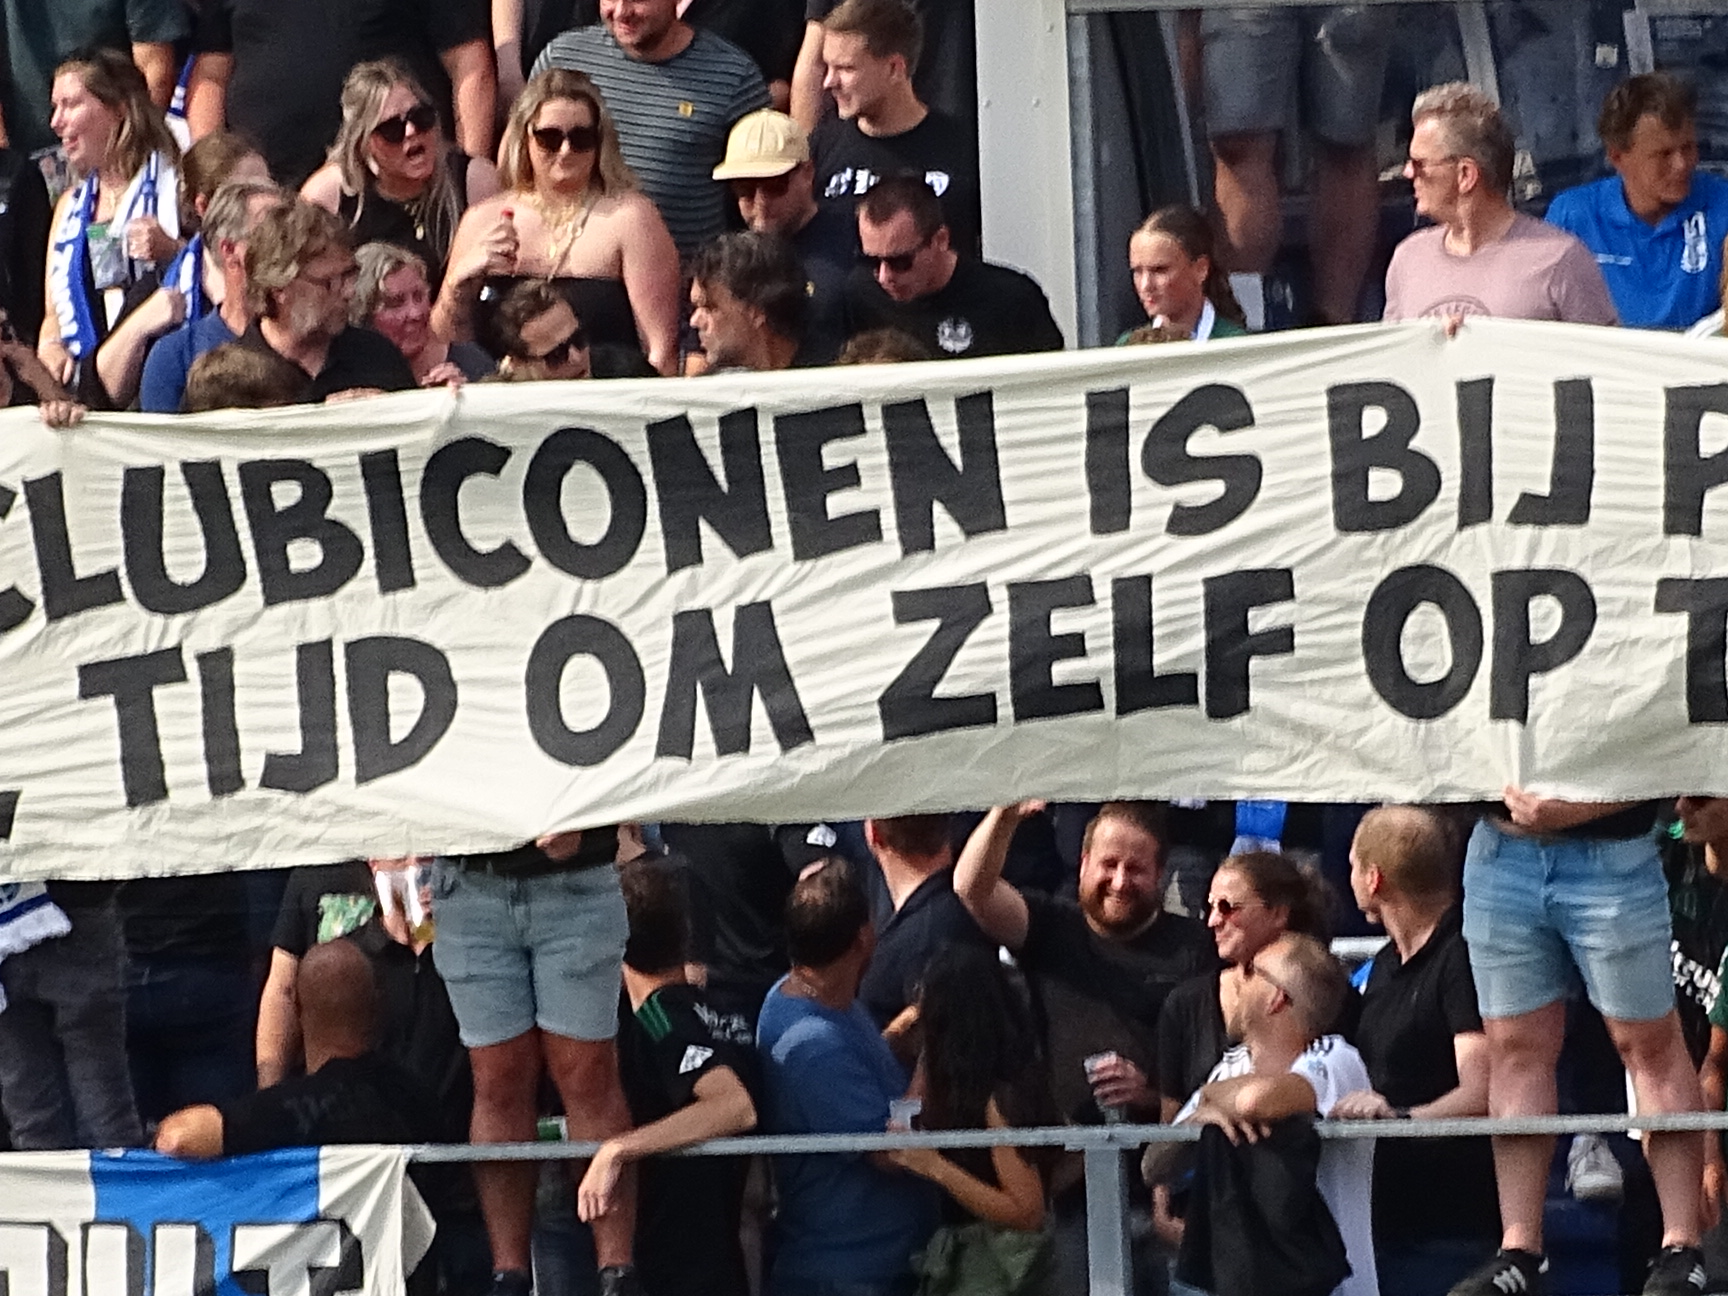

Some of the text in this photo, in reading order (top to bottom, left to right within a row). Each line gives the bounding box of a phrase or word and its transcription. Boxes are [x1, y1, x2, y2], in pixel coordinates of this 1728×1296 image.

[1085, 382, 1264, 537] IS
[1327, 376, 1595, 534] BIJ
[77, 635, 459, 808] TIJD
[524, 600, 815, 768] OM
[876, 566, 1296, 743] ZELF
[1361, 563, 1599, 725] OP
